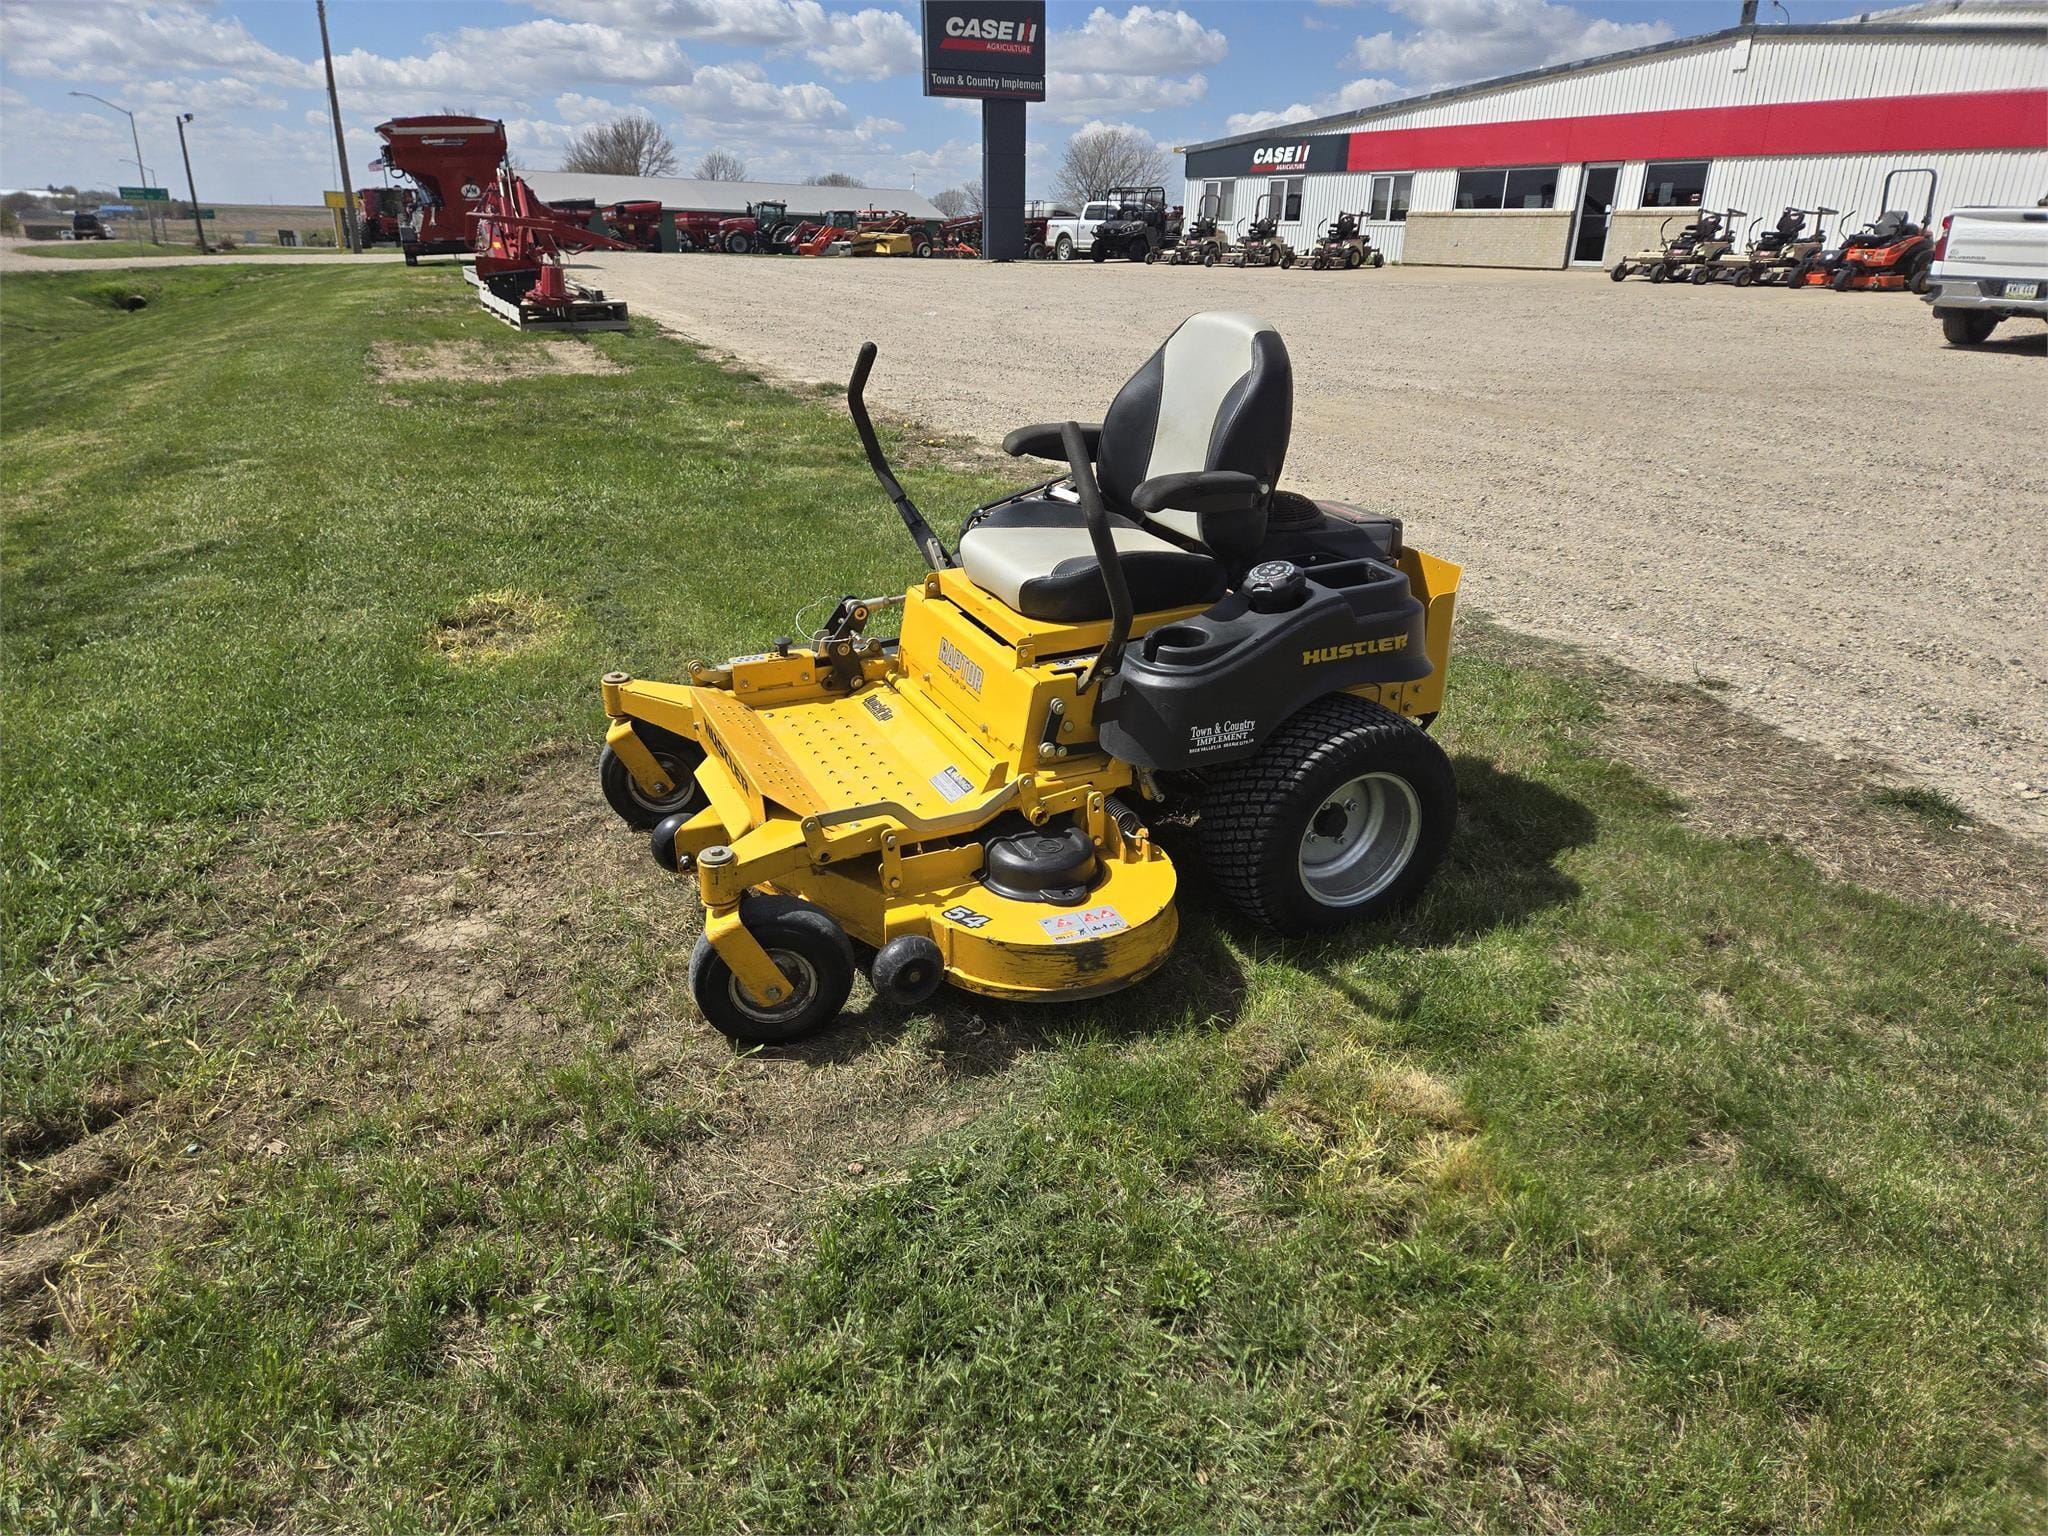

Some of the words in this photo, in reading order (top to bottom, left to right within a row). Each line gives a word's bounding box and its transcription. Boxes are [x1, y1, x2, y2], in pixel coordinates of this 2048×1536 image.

[945, 16, 1015, 41] CASE
[986, 40, 1032, 54] AGRICULTURE
[931, 73, 955, 86] Town
[957, 74, 964, 86] &
[966, 75, 1000, 90] Country
[1001, 75, 1043, 91] Implement
[1253, 146, 1295, 164] CASE
[1275, 163, 1305, 171] AGRICULTURE
[1302, 631, 1409, 666] HUSTLER
[938, 636, 985, 695] RAPTOR
[1190, 726, 1212, 738] Town
[1214, 722, 1221, 734] &
[1223, 719, 1256, 732] Country
[1196, 732, 1249, 747] IMPLEMENT
[703, 716, 751, 799] HUSTLER
[942, 905, 993, 929] 54
